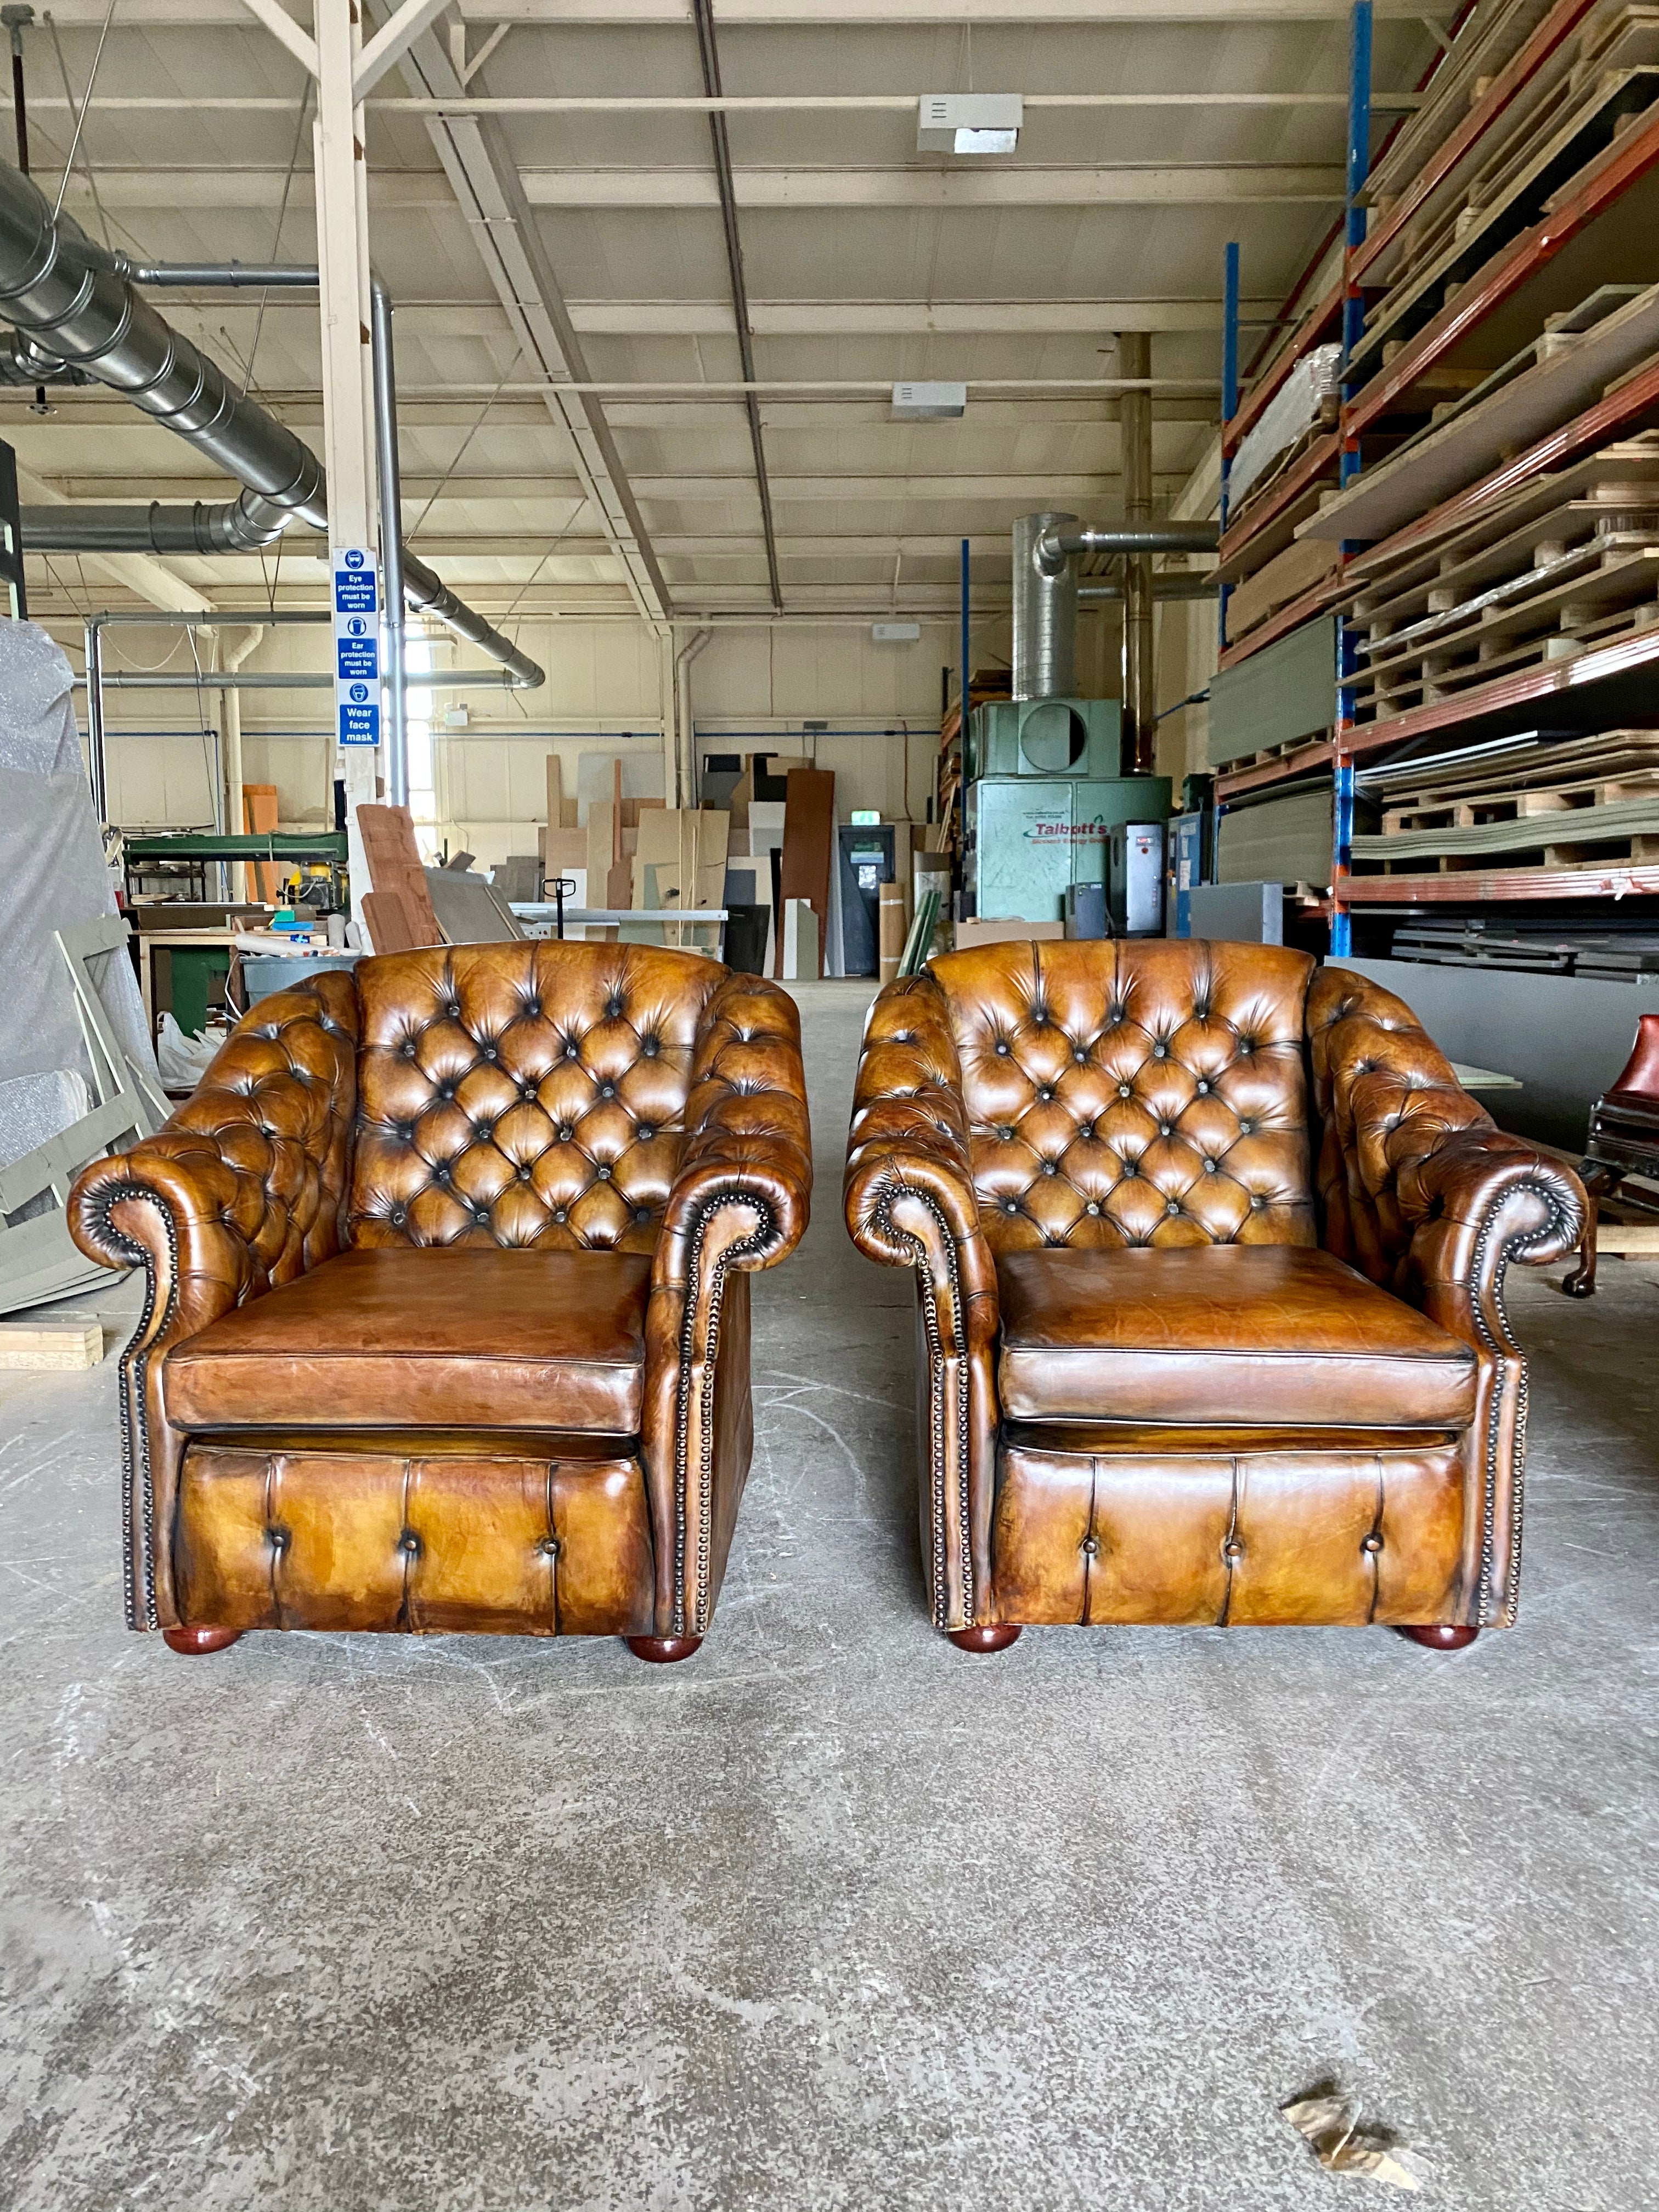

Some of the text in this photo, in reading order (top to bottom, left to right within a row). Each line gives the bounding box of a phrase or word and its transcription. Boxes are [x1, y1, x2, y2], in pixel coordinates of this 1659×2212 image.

[349, 575, 362, 584] Eye
[338, 584, 374, 592] protection
[346, 708, 372, 717] Wear
[349, 720, 370, 730] face
[347, 732, 373, 741] mask
